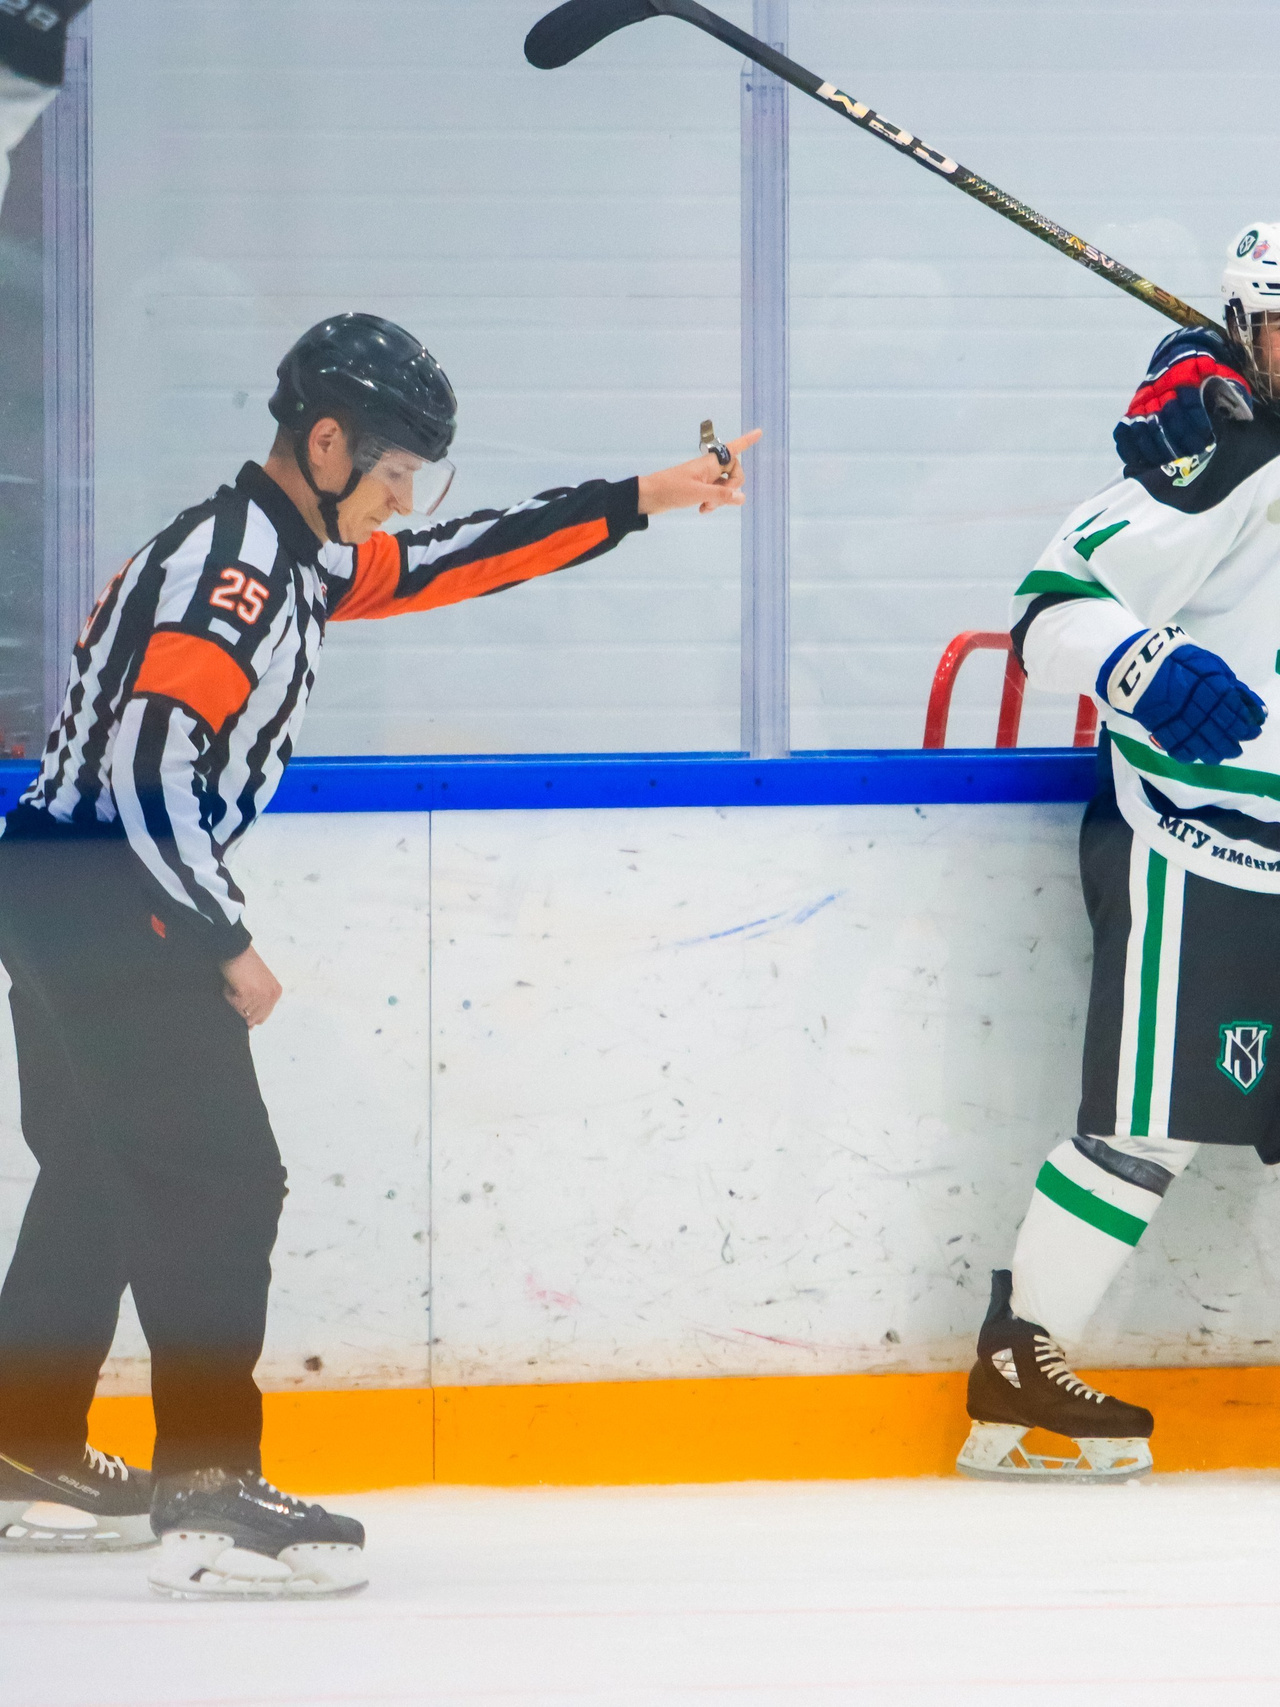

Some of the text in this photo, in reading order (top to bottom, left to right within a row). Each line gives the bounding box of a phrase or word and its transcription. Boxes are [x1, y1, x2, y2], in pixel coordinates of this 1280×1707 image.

[816, 81, 959, 174] CCM
[209, 567, 270, 625] 25
[1117, 625, 1186, 698] CCM
[1157, 814, 1211, 850] МГУ
